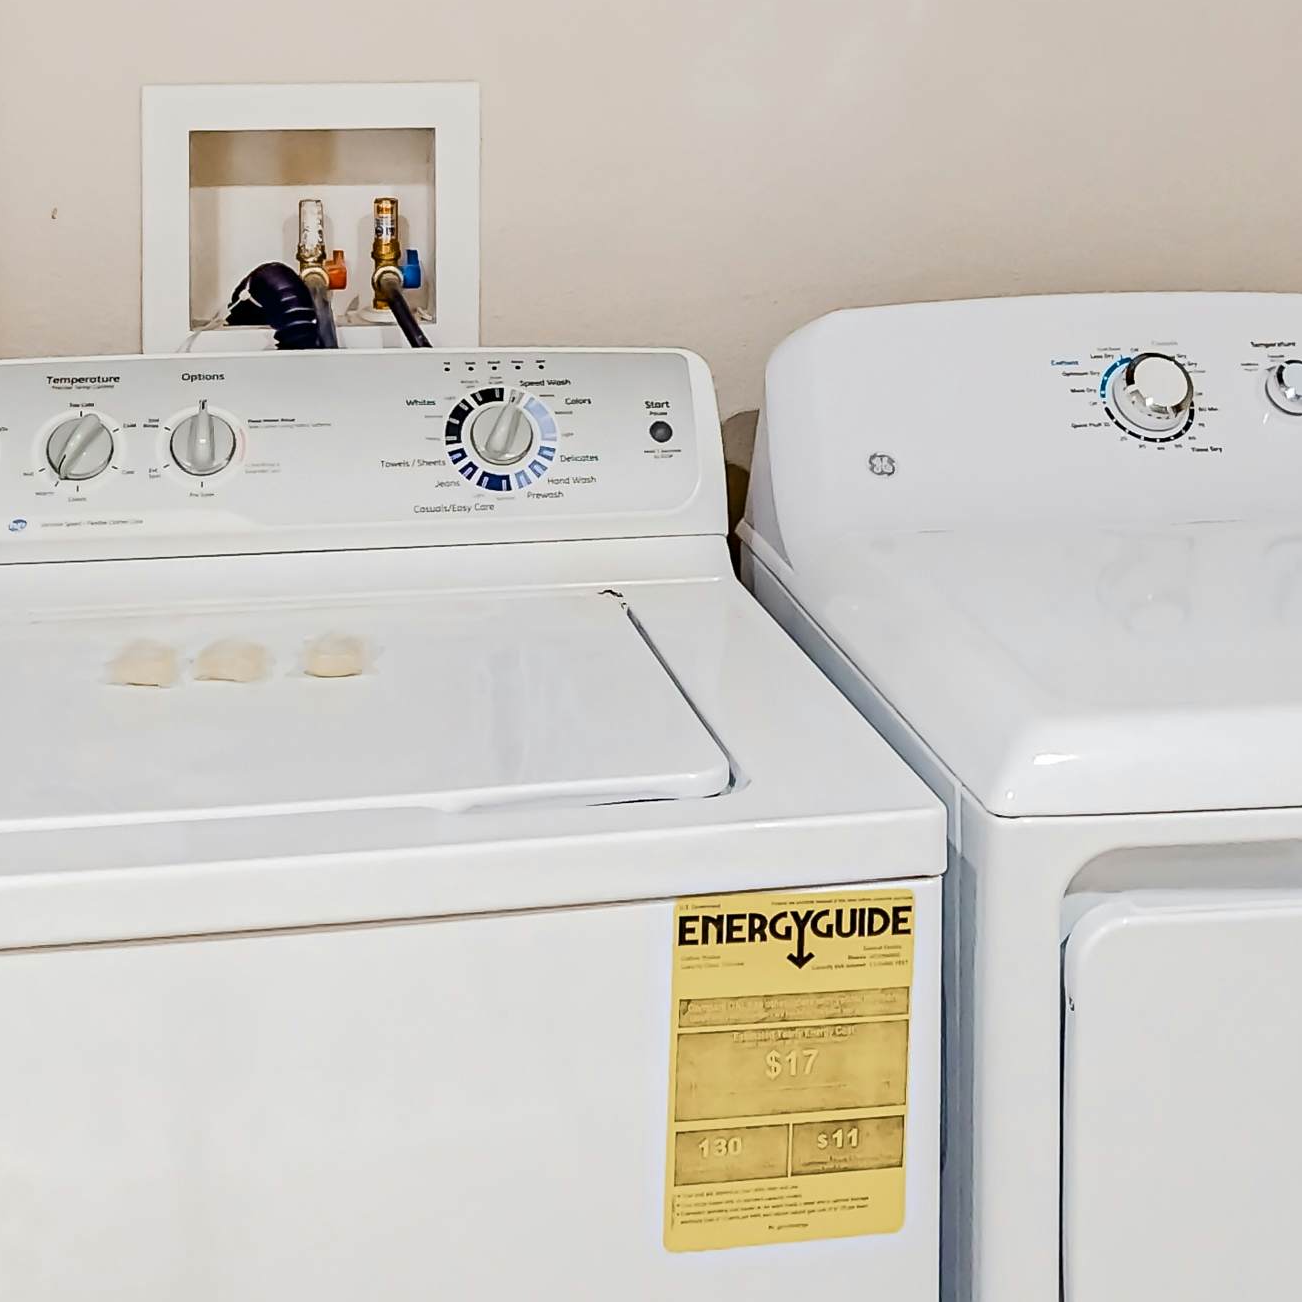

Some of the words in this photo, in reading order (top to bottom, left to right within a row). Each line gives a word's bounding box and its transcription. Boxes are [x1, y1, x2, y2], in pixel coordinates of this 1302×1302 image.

[46, 375, 121, 386] Temperature
[181, 372, 226, 383] Options
[519, 379, 545, 388] Speed
[546, 378, 571, 386] Wash
[405, 399, 437, 407] Whites
[564, 397, 592, 405] Colors
[644, 400, 671, 409] Start
[560, 454, 599, 463] Delicates
[380, 460, 411, 468] Towels
[417, 459, 447, 467] Sheets
[434, 480, 461, 488] Jeans
[548, 477, 570, 485] Hand
[571, 476, 597, 484] Wash
[527, 490, 564, 499] Prewash
[474, 502, 495, 511] Care
[677, 905, 913, 948] ENERGYGUIDE
[765, 1048, 819, 1080] $17
[698, 1137, 743, 1159] 130
